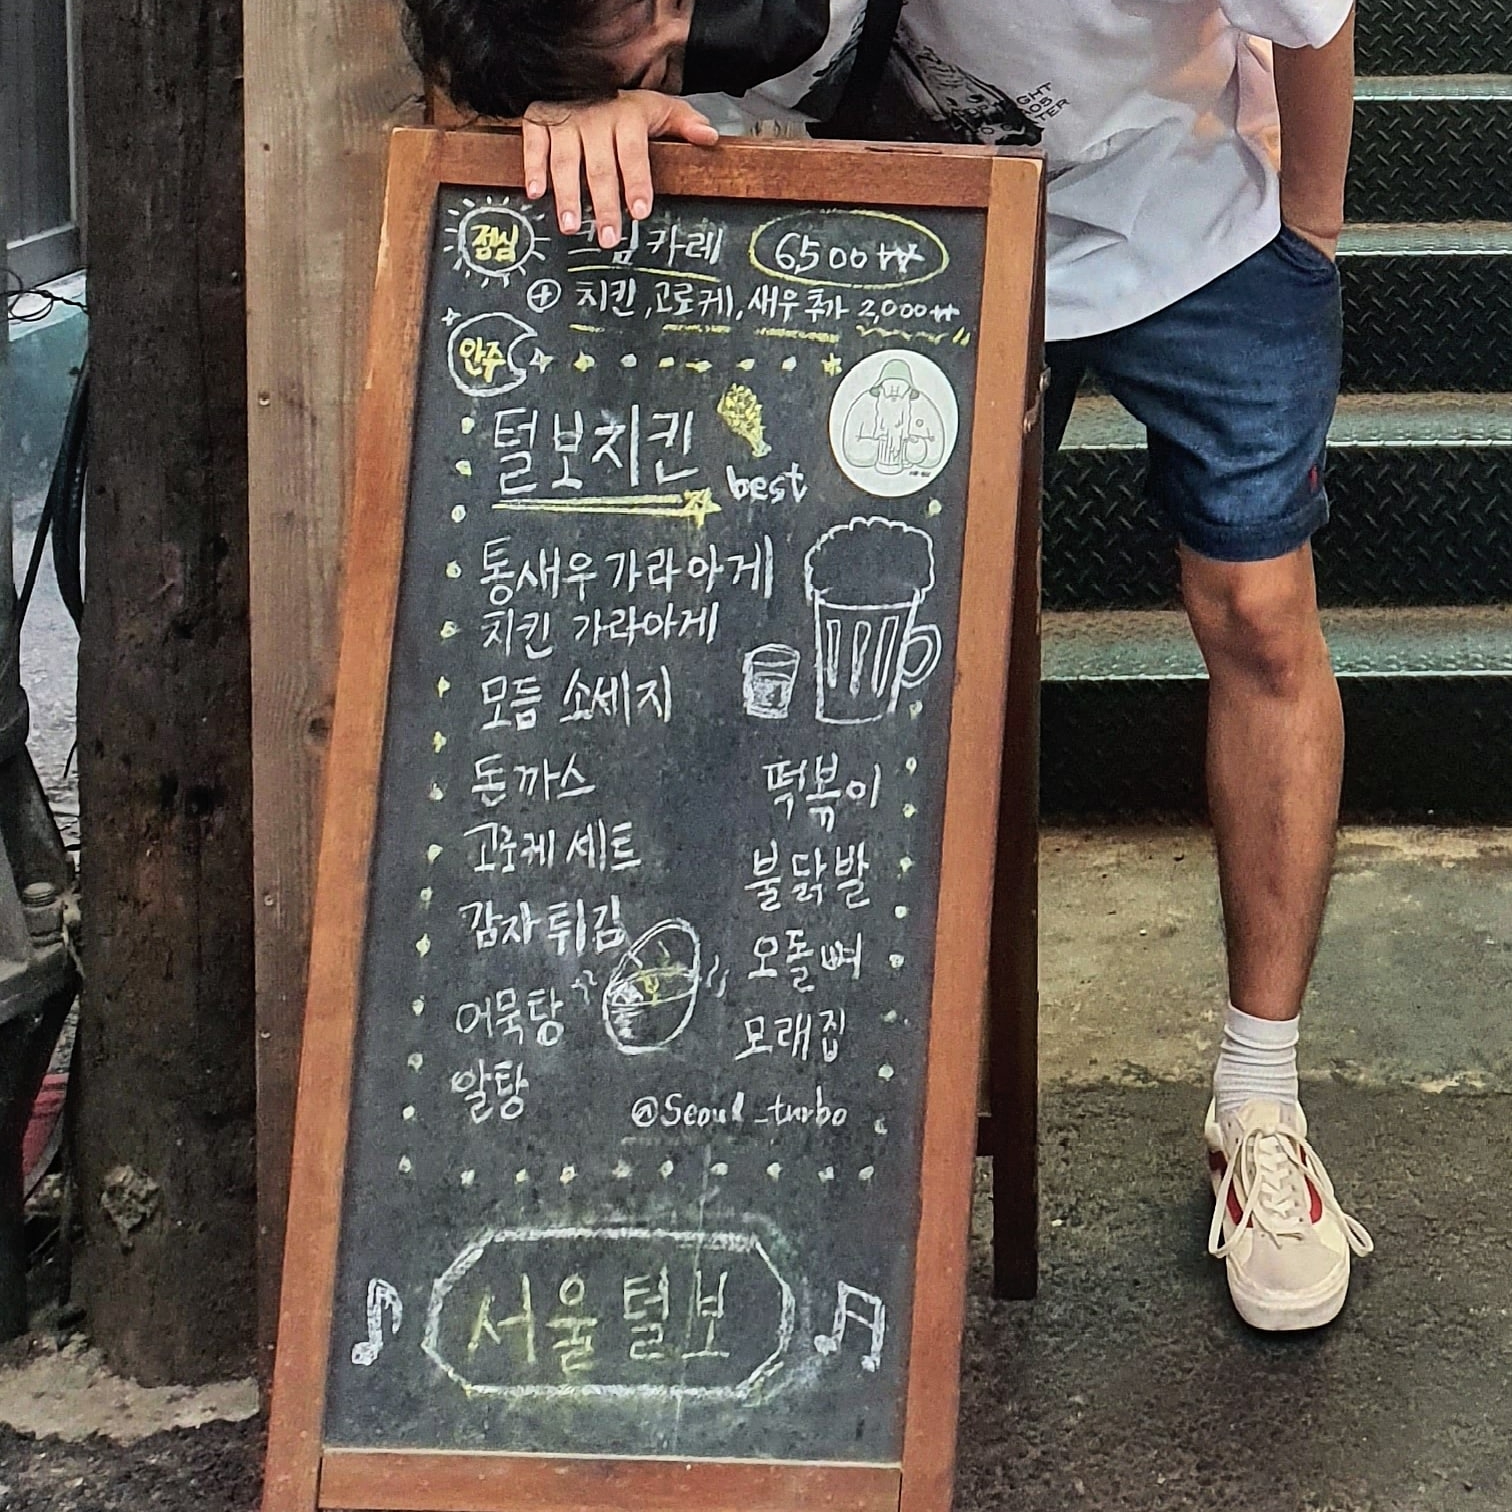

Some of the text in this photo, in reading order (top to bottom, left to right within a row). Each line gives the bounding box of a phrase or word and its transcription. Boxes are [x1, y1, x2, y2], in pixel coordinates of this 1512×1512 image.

[470, 222, 520, 263] 점심
[645, 222, 724, 268] 카레
[459, 336, 507, 384] 안주
[724, 460, 810, 505] best
[479, 533, 775, 606] 통새우 가라아게
[480, 601, 721, 660] 치킨 가라아게
[480, 664, 673, 732] 모듬 소세지
[470, 751, 597, 807] 돈까스
[565, 817, 643, 874] 세트
[743, 837, 872, 913] 불닭발
[457, 893, 630, 959] 감자 튀김
[454, 986, 565, 1048] 어묵탕
[734, 1006, 847, 1064] 모래집
[450, 1057, 531, 1125] 알탕
